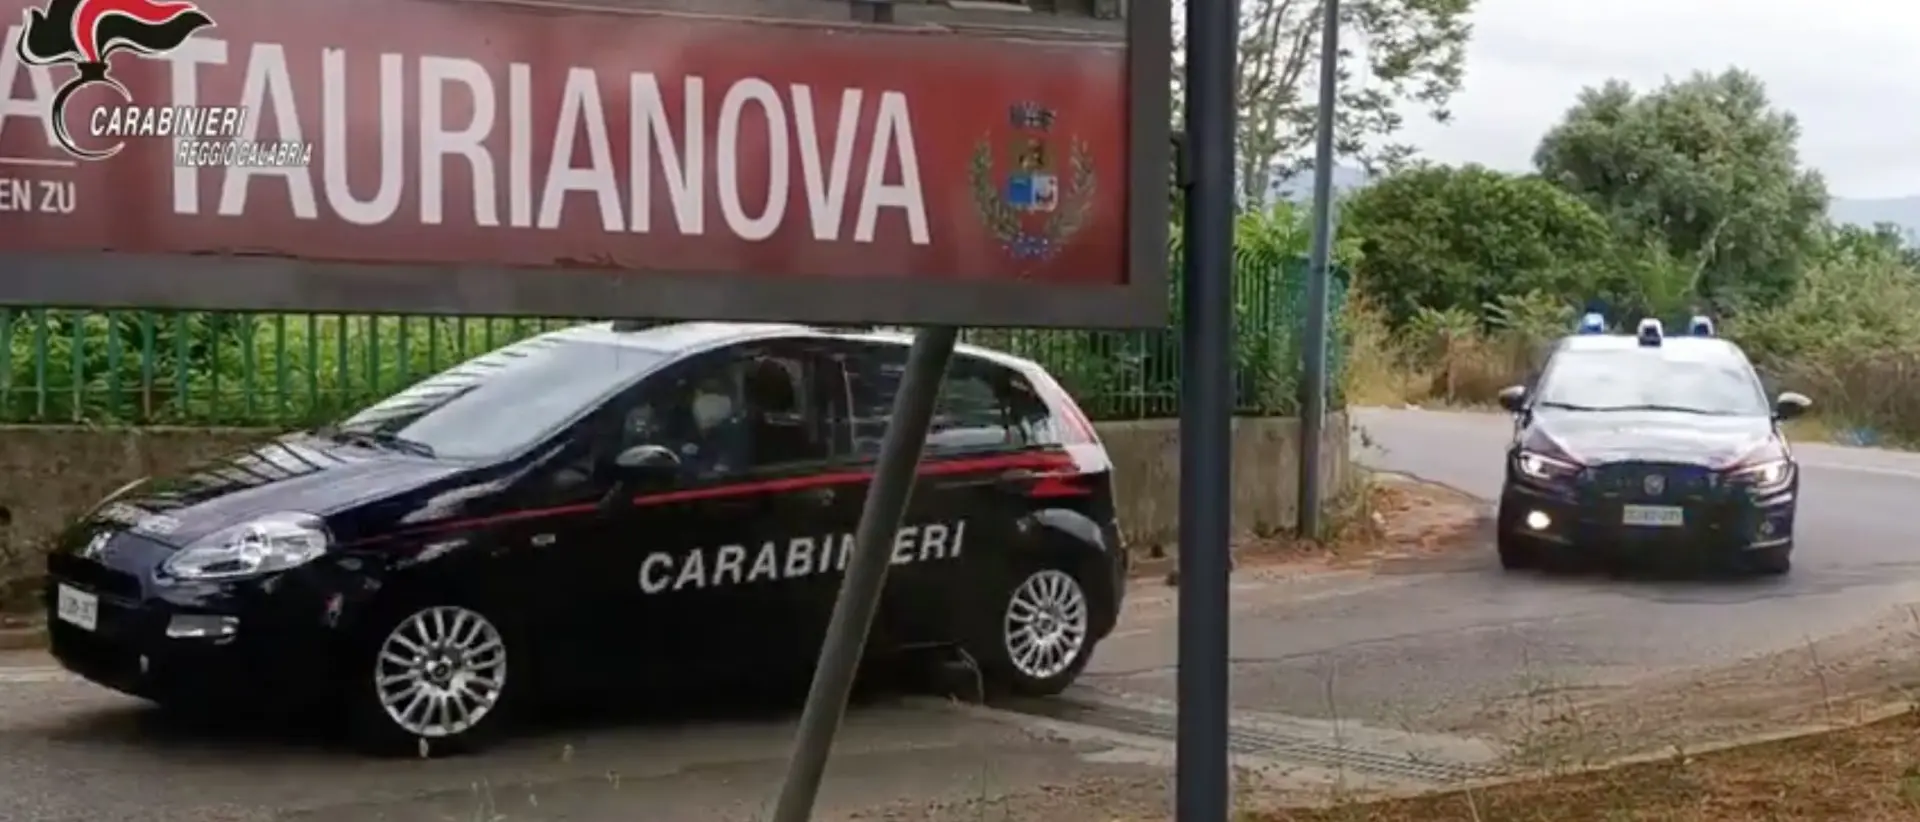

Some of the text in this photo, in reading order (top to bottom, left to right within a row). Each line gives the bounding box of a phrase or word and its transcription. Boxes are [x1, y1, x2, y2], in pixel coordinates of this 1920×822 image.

[138, 39, 930, 245] TAURIANOVA
[39, 181, 77, 213] ZU
[638, 521, 966, 595] CARABINERI
